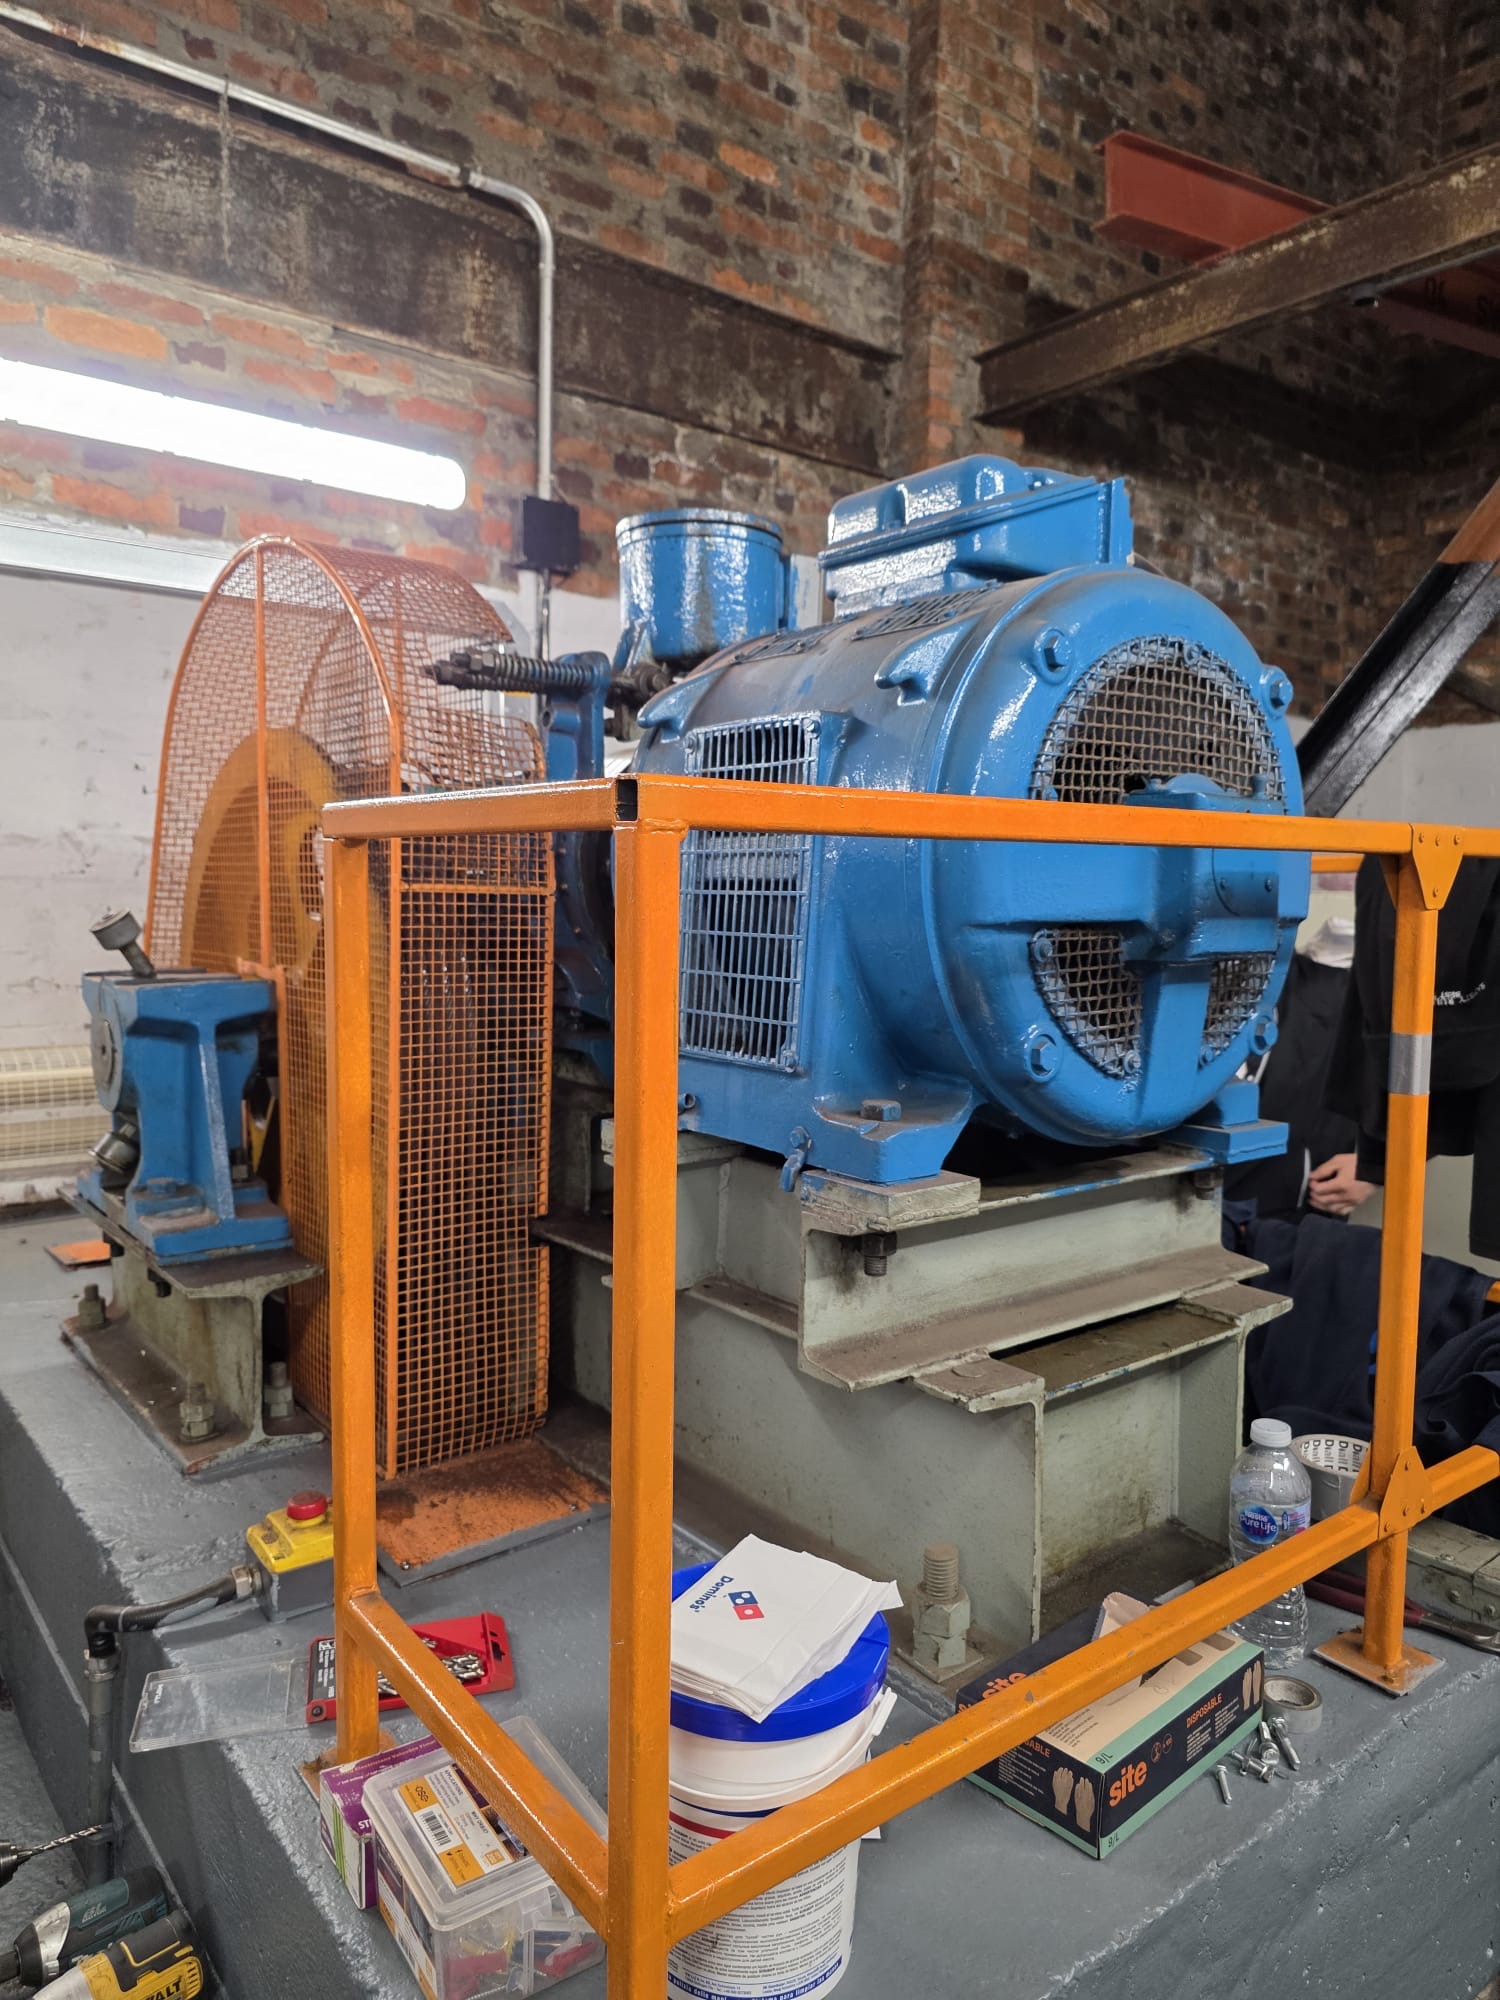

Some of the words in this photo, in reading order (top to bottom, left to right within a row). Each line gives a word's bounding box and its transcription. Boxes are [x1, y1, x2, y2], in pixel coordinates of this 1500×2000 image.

[1260, 1520, 1278, 1534] Life
[689, 1575, 735, 1612] Domino's
[1187, 1693, 1223, 1729] DISPOSABLE
[1109, 1761, 1148, 1808] site
[358, 1819, 373, 1830] ST
[145, 1979, 182, 2000] ALT
